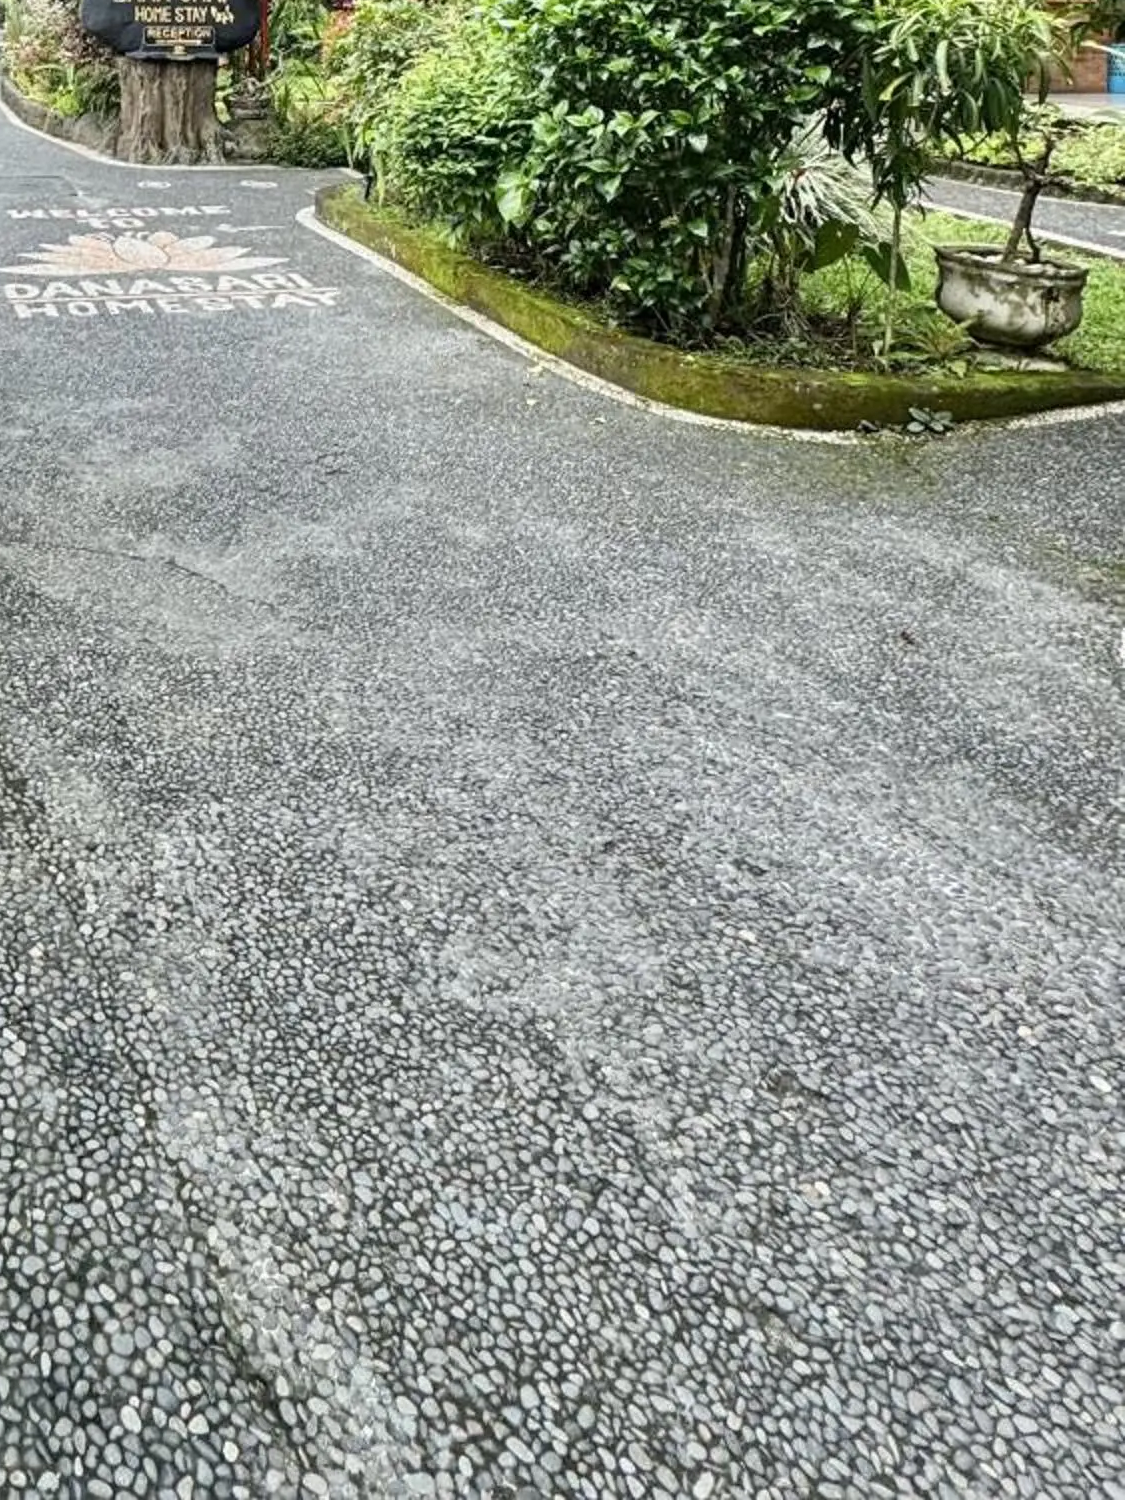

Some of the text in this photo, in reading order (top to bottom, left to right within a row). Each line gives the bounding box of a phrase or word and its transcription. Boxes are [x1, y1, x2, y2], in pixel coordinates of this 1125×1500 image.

[134, 6, 208, 23] HOME STAY
[146, 26, 212, 39] RECEPTION
[7, 205, 231, 219] WELCOME
[77, 217, 145, 229] TO
[3, 273, 313, 299] DANASARI
